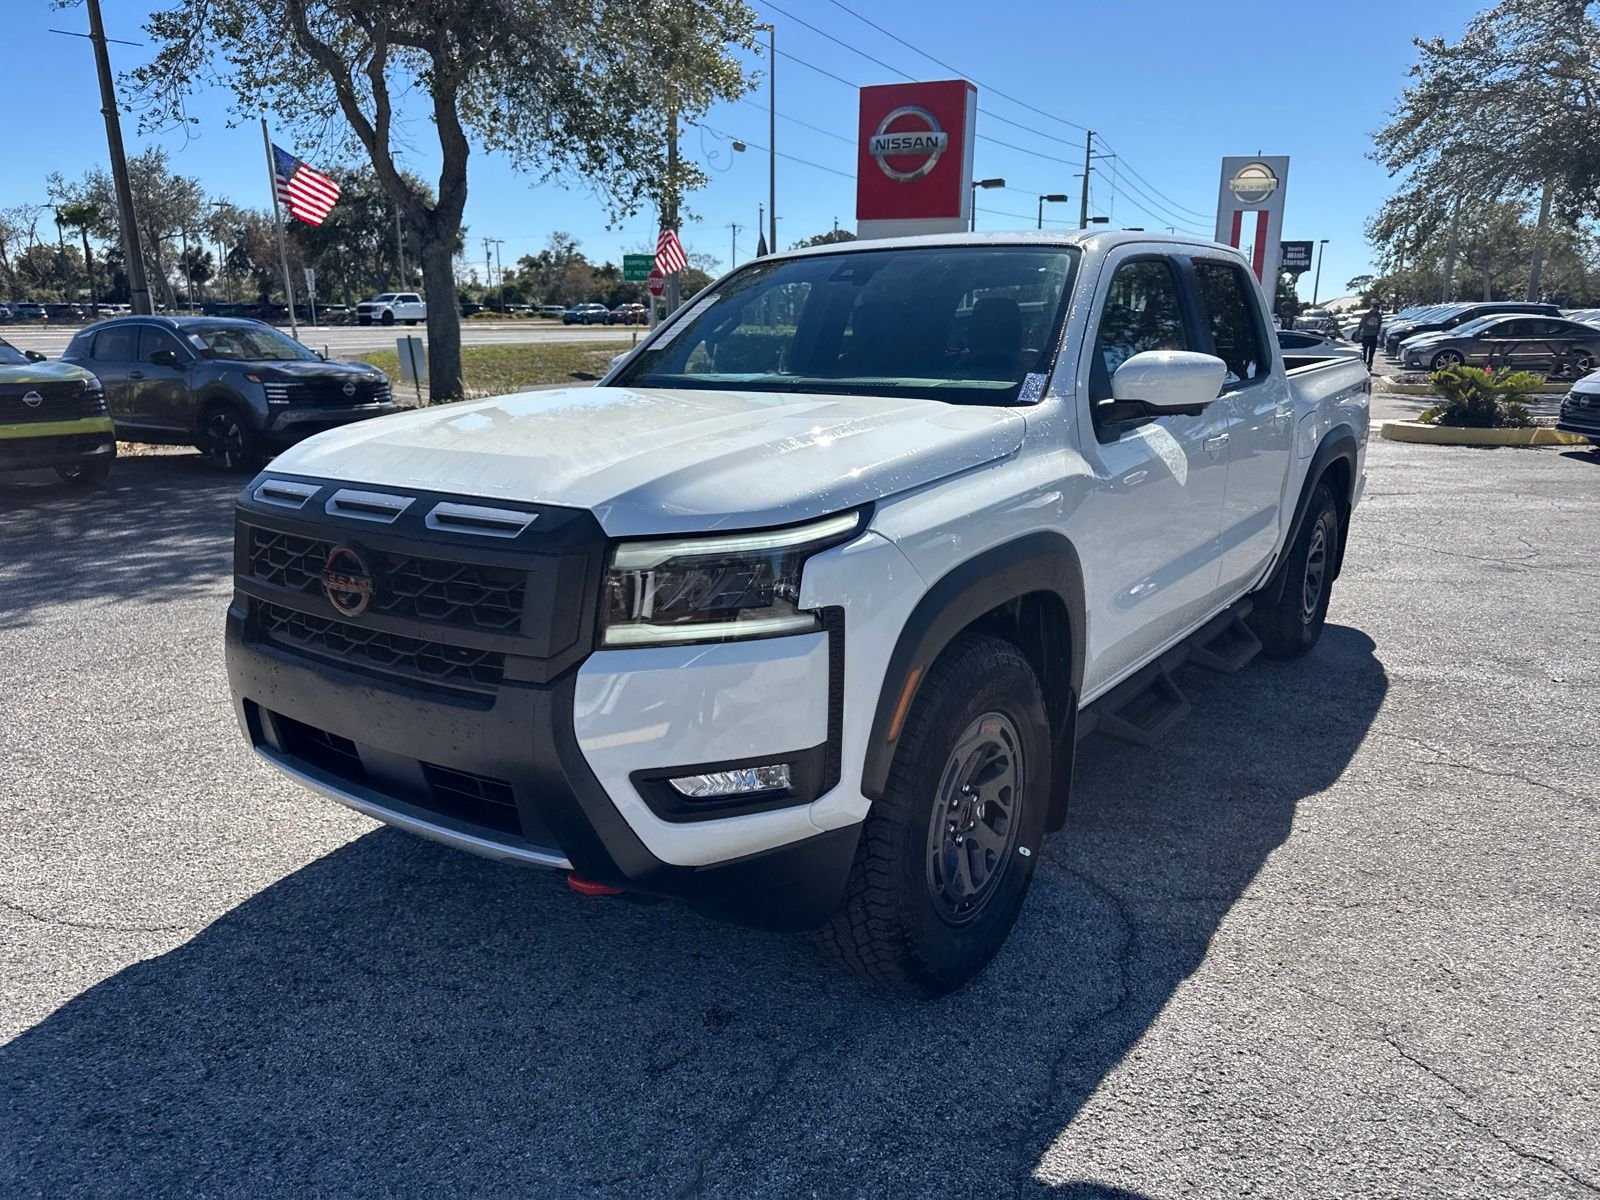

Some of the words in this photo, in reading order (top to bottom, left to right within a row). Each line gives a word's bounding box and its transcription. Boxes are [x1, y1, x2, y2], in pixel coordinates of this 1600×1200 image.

[875, 136, 939, 151] NISSAN
[1282, 259, 1310, 267] Storage
[648, 277, 664, 289] STOP
[323, 572, 372, 592] ISSAN
